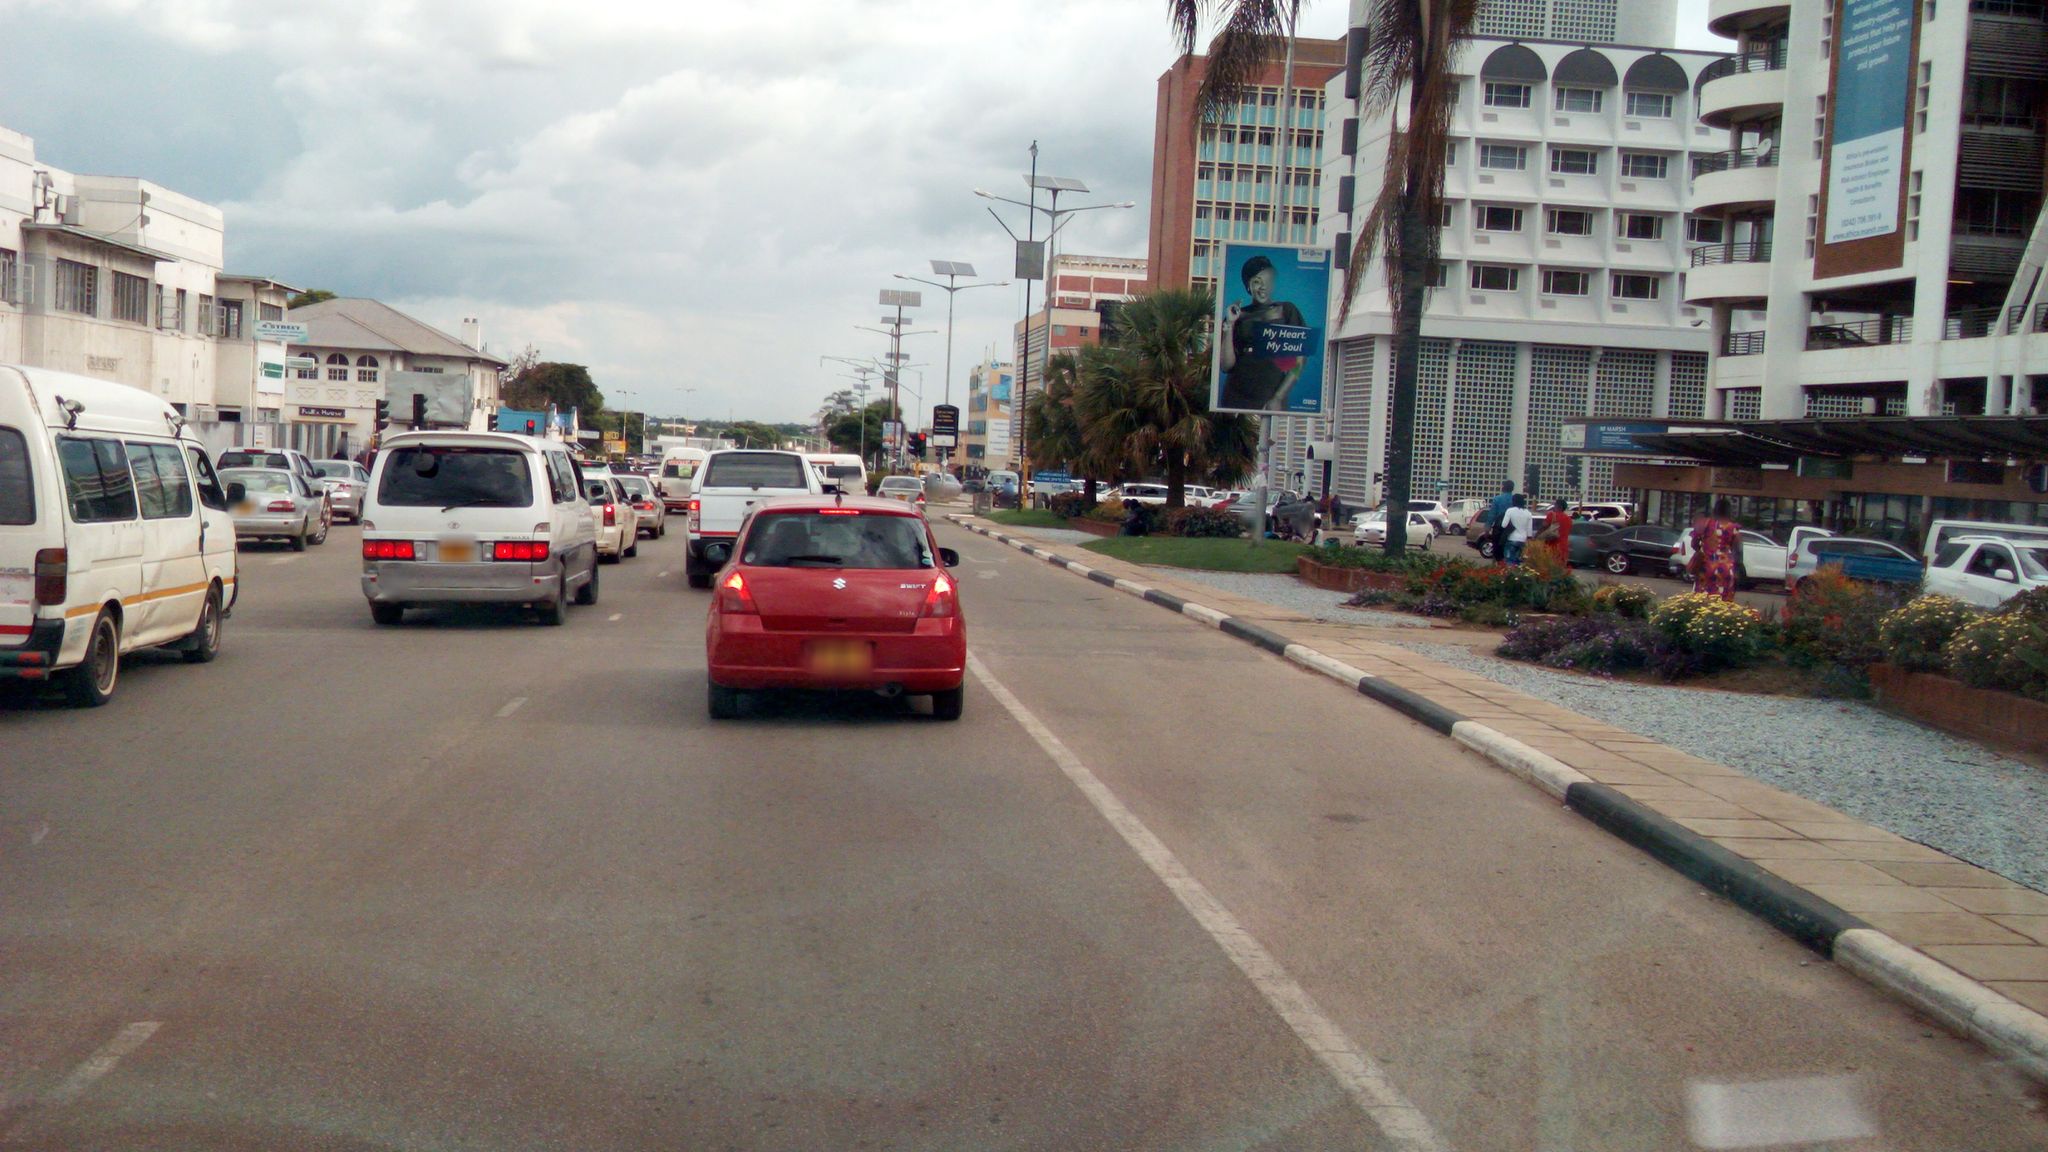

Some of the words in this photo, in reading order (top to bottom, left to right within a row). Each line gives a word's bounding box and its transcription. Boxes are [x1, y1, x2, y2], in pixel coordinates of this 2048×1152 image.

[1870, 27, 1882, 37] that
[1882, 23, 1896, 34] help
[1896, 18, 1908, 30] you
[1848, 44, 1868, 60] protect
[1869, 41, 1882, 53] your
[1883, 35, 1901, 46] future
[1857, 60, 1868, 71] and
[1869, 54, 1889, 69] growth
[1263, 328, 1277, 340] My
[1266, 341, 1281, 353] My
[1282, 342, 1303, 352] Soul
